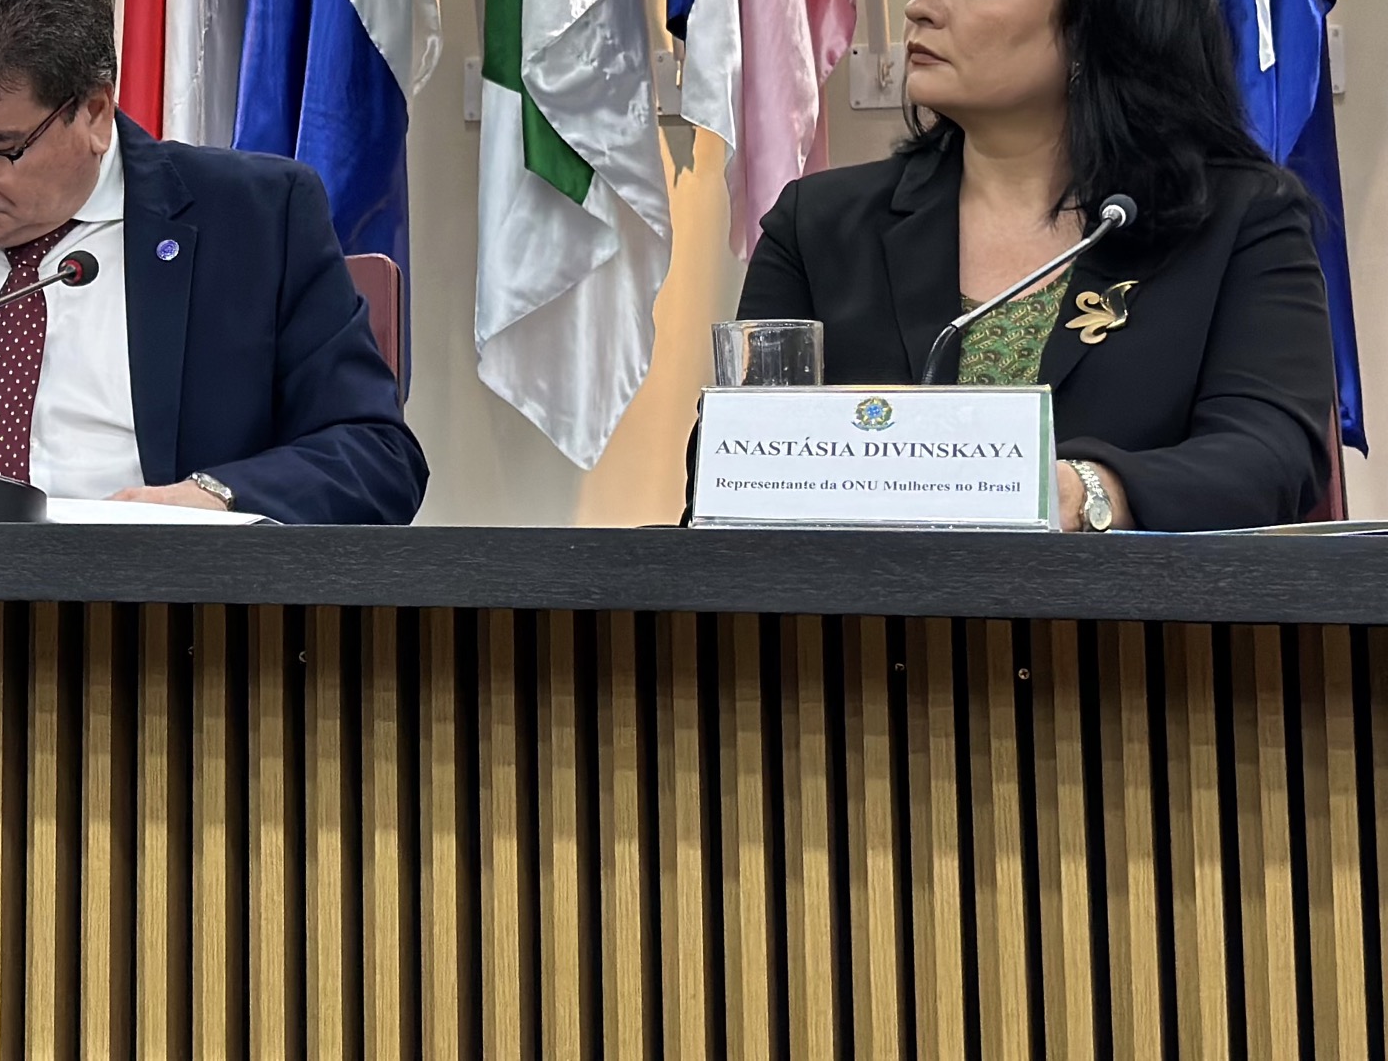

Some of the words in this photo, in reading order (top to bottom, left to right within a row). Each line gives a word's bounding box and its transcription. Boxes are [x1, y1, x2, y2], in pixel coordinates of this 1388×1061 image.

[715, 436, 856, 457] ANASTÁSIA
[863, 441, 1024, 459] DIVINSKAYA
[715, 477, 816, 491] Representante
[820, 479, 838, 490] da
[841, 480, 879, 491] ONU
[883, 480, 951, 492] Mulheres
[954, 482, 973, 492] no
[977, 480, 1022, 493] Brasil
